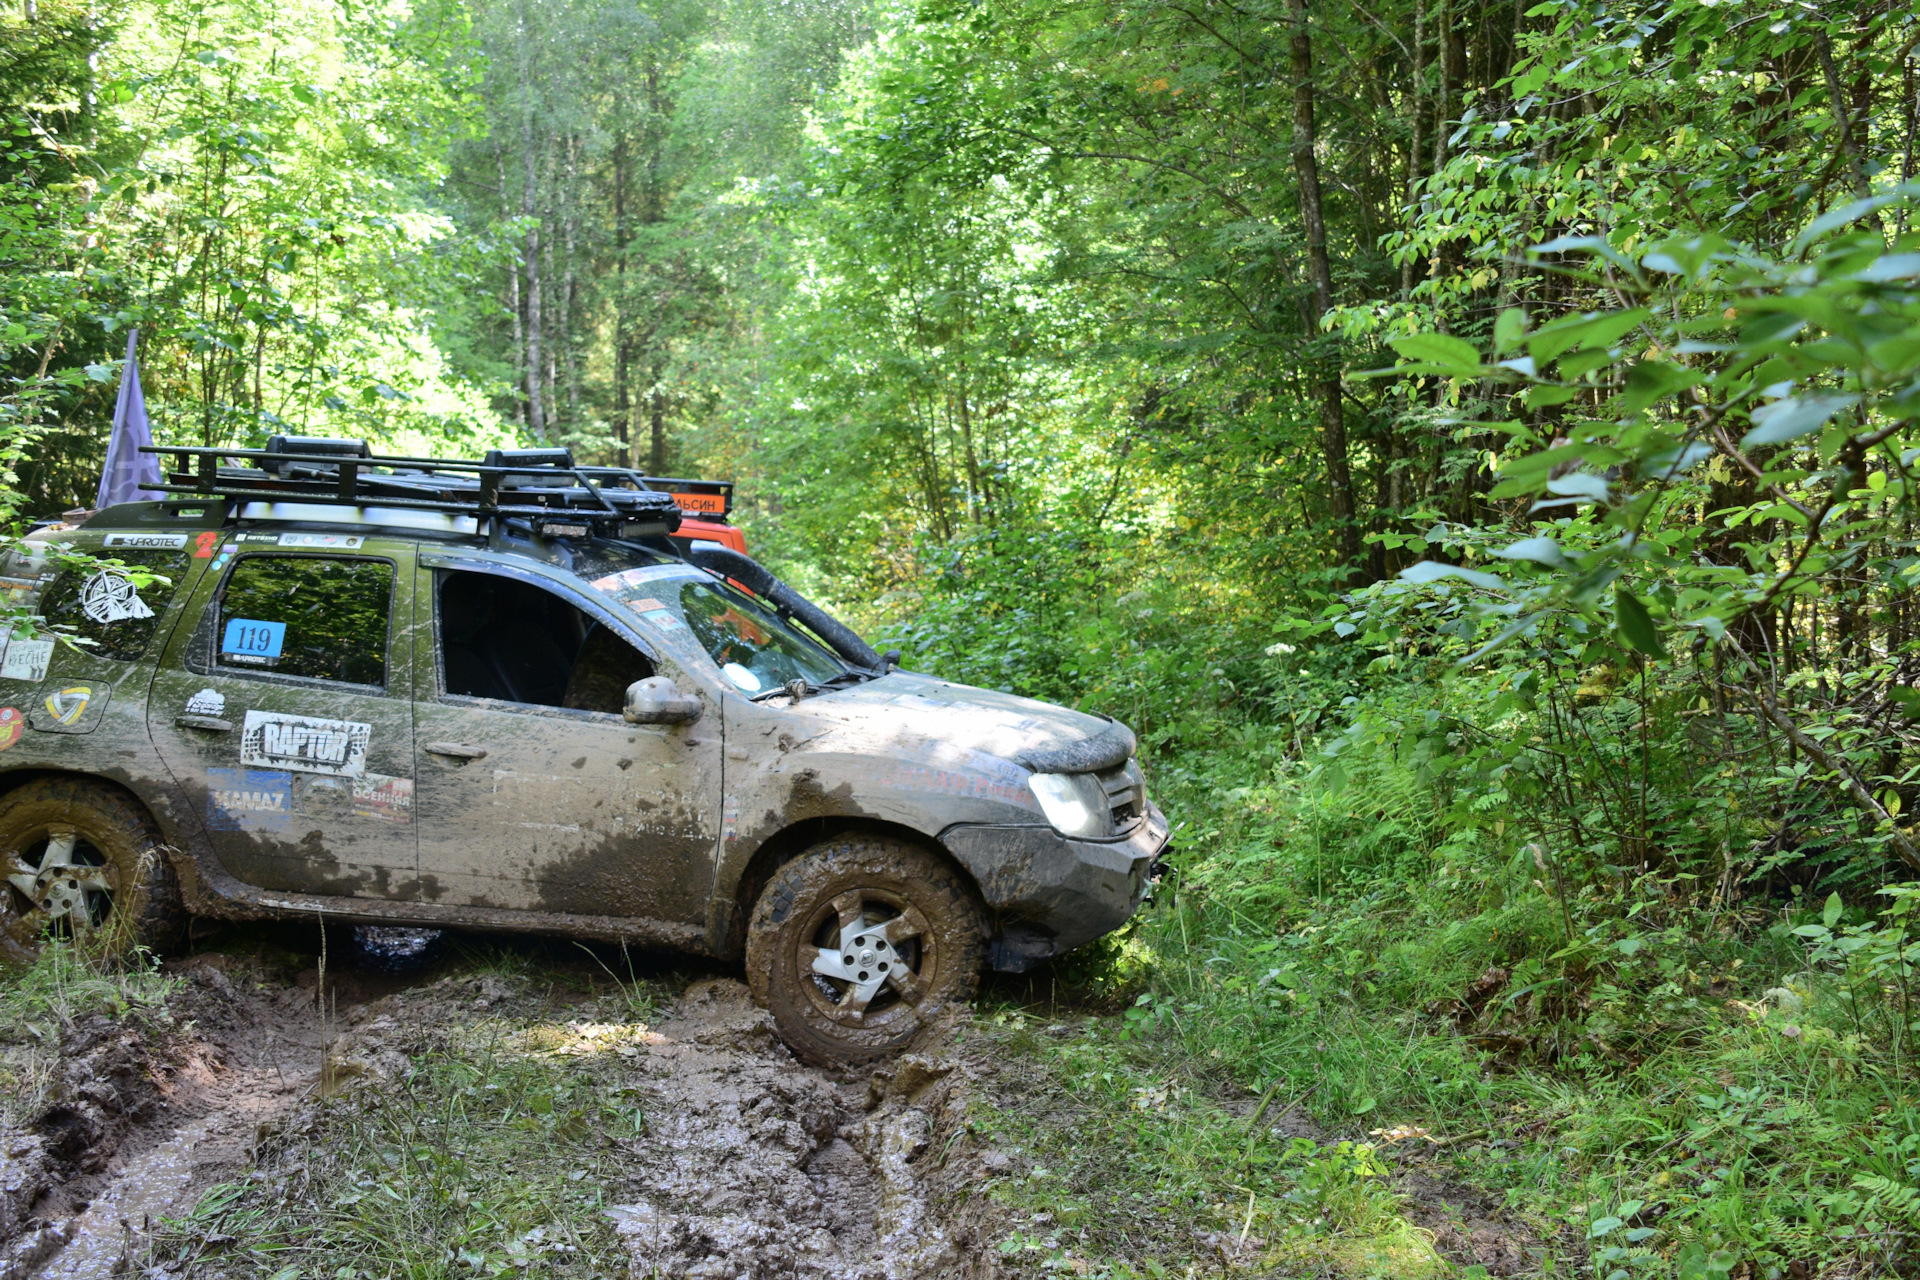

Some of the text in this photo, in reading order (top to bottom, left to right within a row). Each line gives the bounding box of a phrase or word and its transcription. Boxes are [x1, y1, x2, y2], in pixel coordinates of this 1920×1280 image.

[124, 537, 181, 548] SUPROTEC
[193, 531, 217, 558] 2
[236, 626, 272, 652] 119
[264, 722, 349, 763] RAPTOR
[214, 789, 286, 812] KAMAZ
